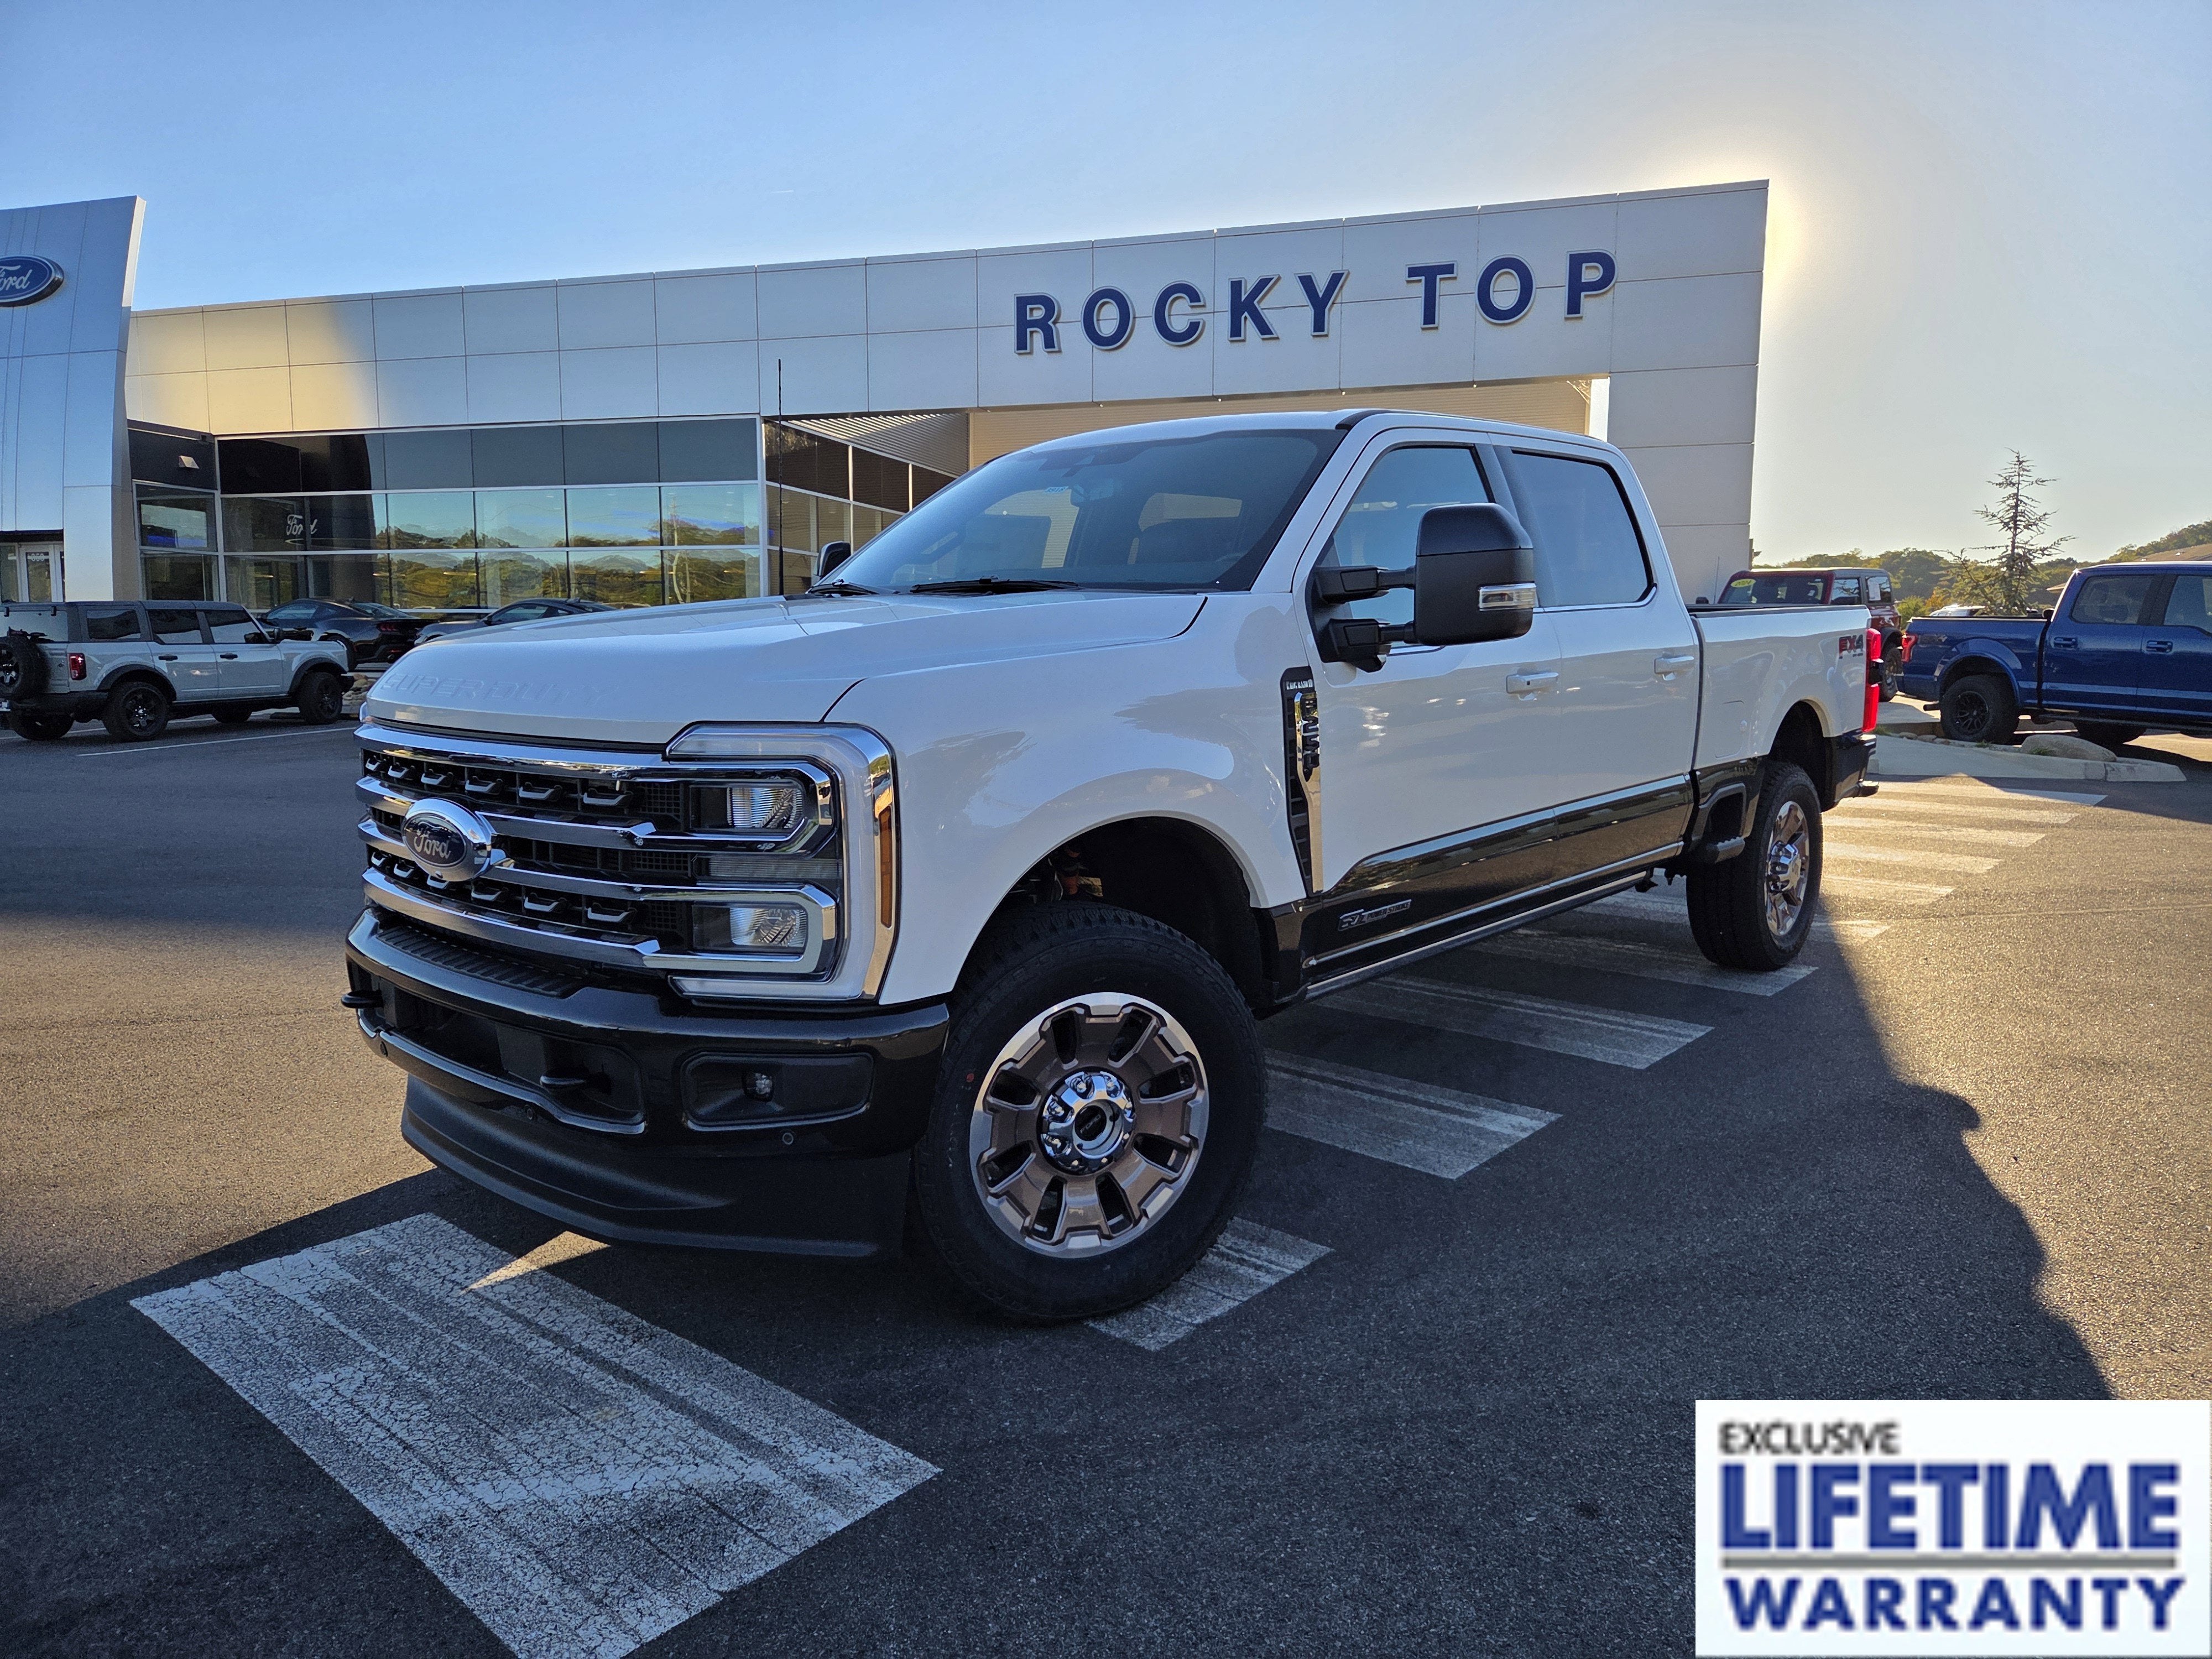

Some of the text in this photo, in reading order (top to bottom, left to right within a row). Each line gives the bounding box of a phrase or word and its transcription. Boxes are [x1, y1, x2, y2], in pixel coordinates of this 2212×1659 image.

[1013, 249, 1618, 354] ROCKY TOP
[1839, 634, 1864, 659] FX4
[380, 672, 486, 700] SUPER
[413, 821, 452, 859] Ford
